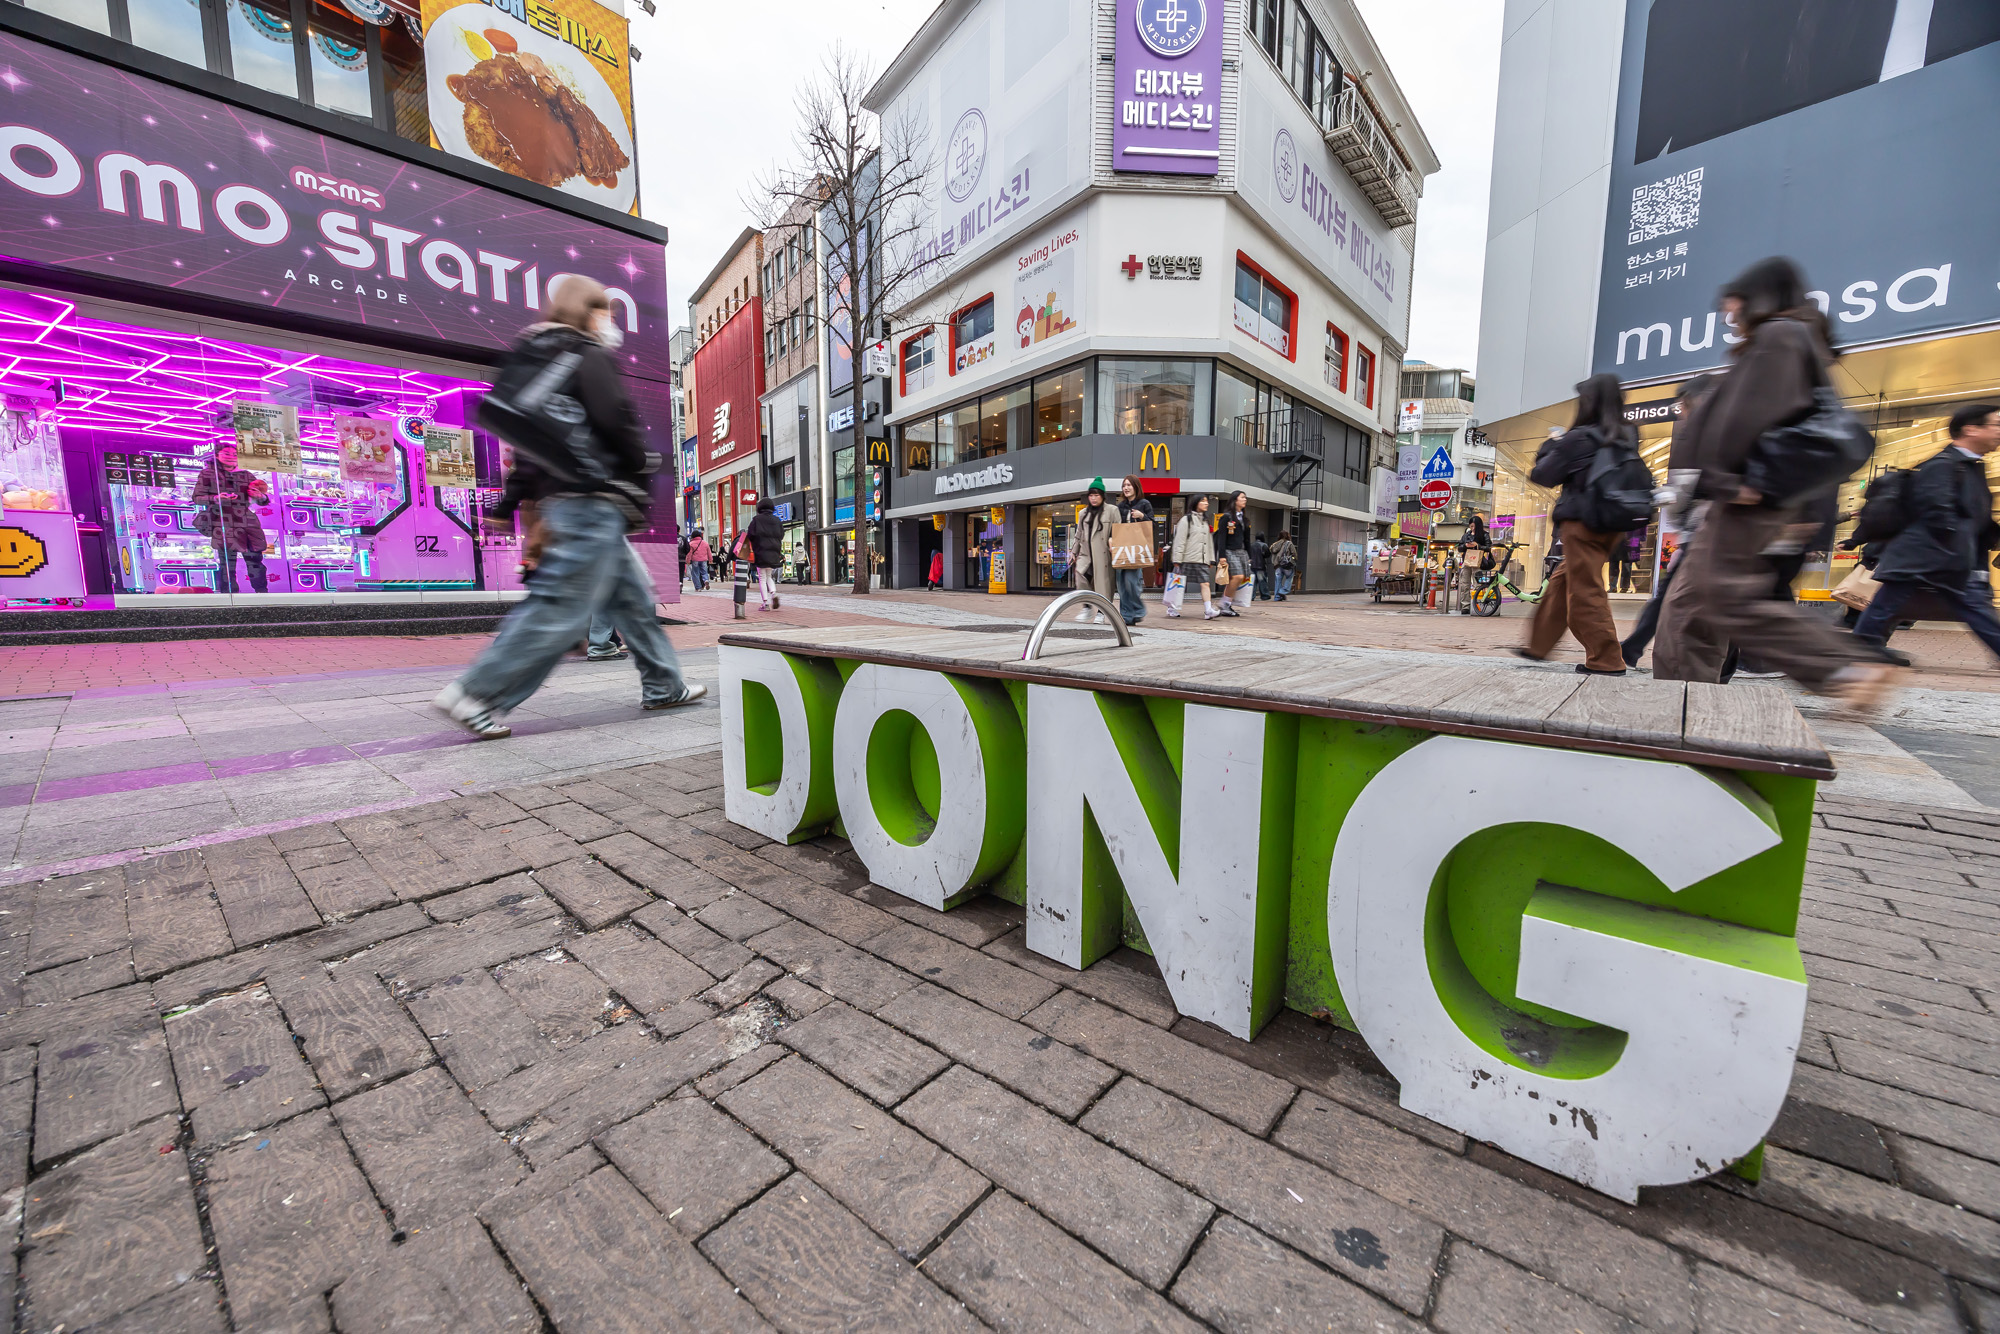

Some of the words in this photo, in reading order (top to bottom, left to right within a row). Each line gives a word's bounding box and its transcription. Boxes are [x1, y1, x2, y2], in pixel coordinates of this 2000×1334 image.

[1145, 23, 1197, 46] MEDISKIN
[1135, 69, 1204, 97] 데자뷰
[1122, 101, 1213, 130] 메디스킨
[912, 225, 956, 278] 데자뷰
[960, 167, 1030, 246] 메디스킨
[1301, 162, 1347, 250] 데자뷰
[1350, 220, 1395, 303] 메디스킨
[1018, 244, 1049, 271] Saving
[1051, 229, 1079, 253] Lives,
[1147, 254, 1203, 274] 헌혈의집
[1626, 246, 1670, 270] 한소희
[1673, 242, 1689, 256] 룩
[284, 269, 407, 304] ARCADE
[1624, 270, 1653, 289] 보러
[1657, 262, 1687, 281] 가기
[935, 463, 1013, 495] McDonald's
[415, 536, 439, 552] 02
[1111, 543, 1155, 566] ZARA
[719, 645, 1807, 1206] DONG
